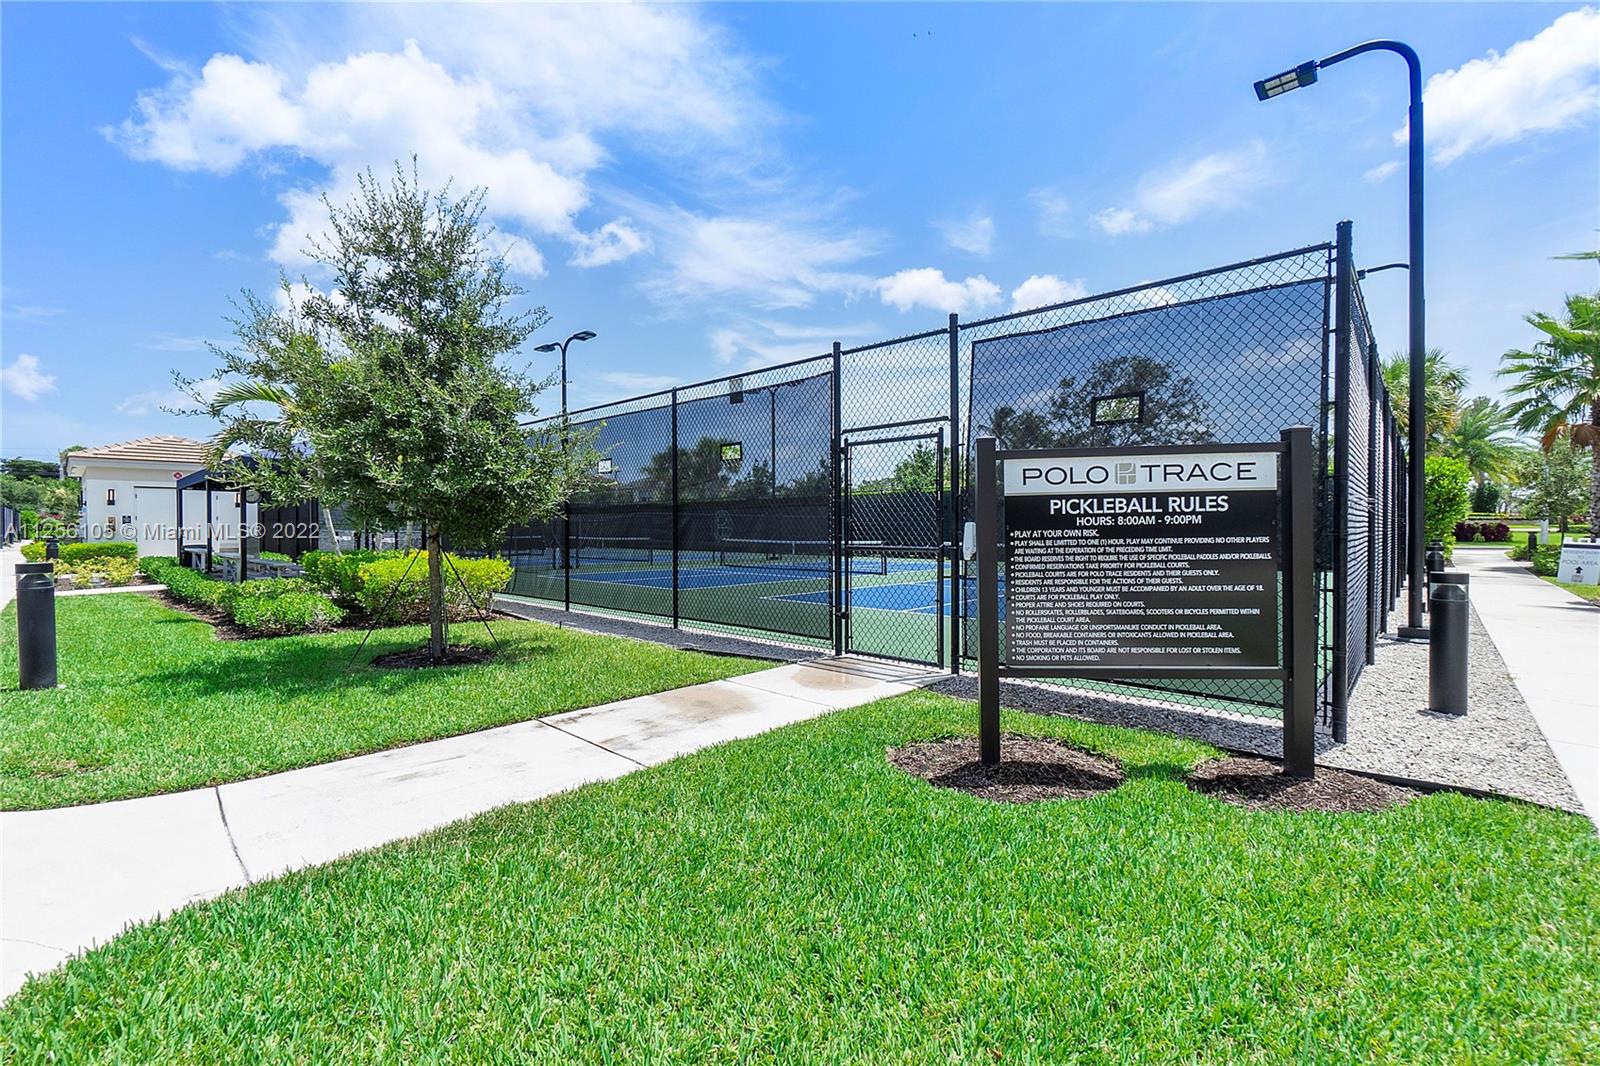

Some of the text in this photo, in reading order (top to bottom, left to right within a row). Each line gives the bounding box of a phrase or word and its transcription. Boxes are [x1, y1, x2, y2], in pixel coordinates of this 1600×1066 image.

[1022, 462, 1257, 485] POLO TRACE
[1050, 496, 1229, 515] PICKLEBALL RULES
[1076, 516, 1115, 526] HOURS:
[1117, 515, 1156, 525] 8:00AM
[1164, 515, 1202, 525] 9:00PM
[1015, 530, 1031, 538] PLAY
[1032, 530, 1042, 538] AT
[1042, 530, 1062, 538] YOUR
[1063, 530, 1082, 538] OWN
[1126, 538, 1140, 546] PLAY
[1140, 538, 1154, 546] MAY
